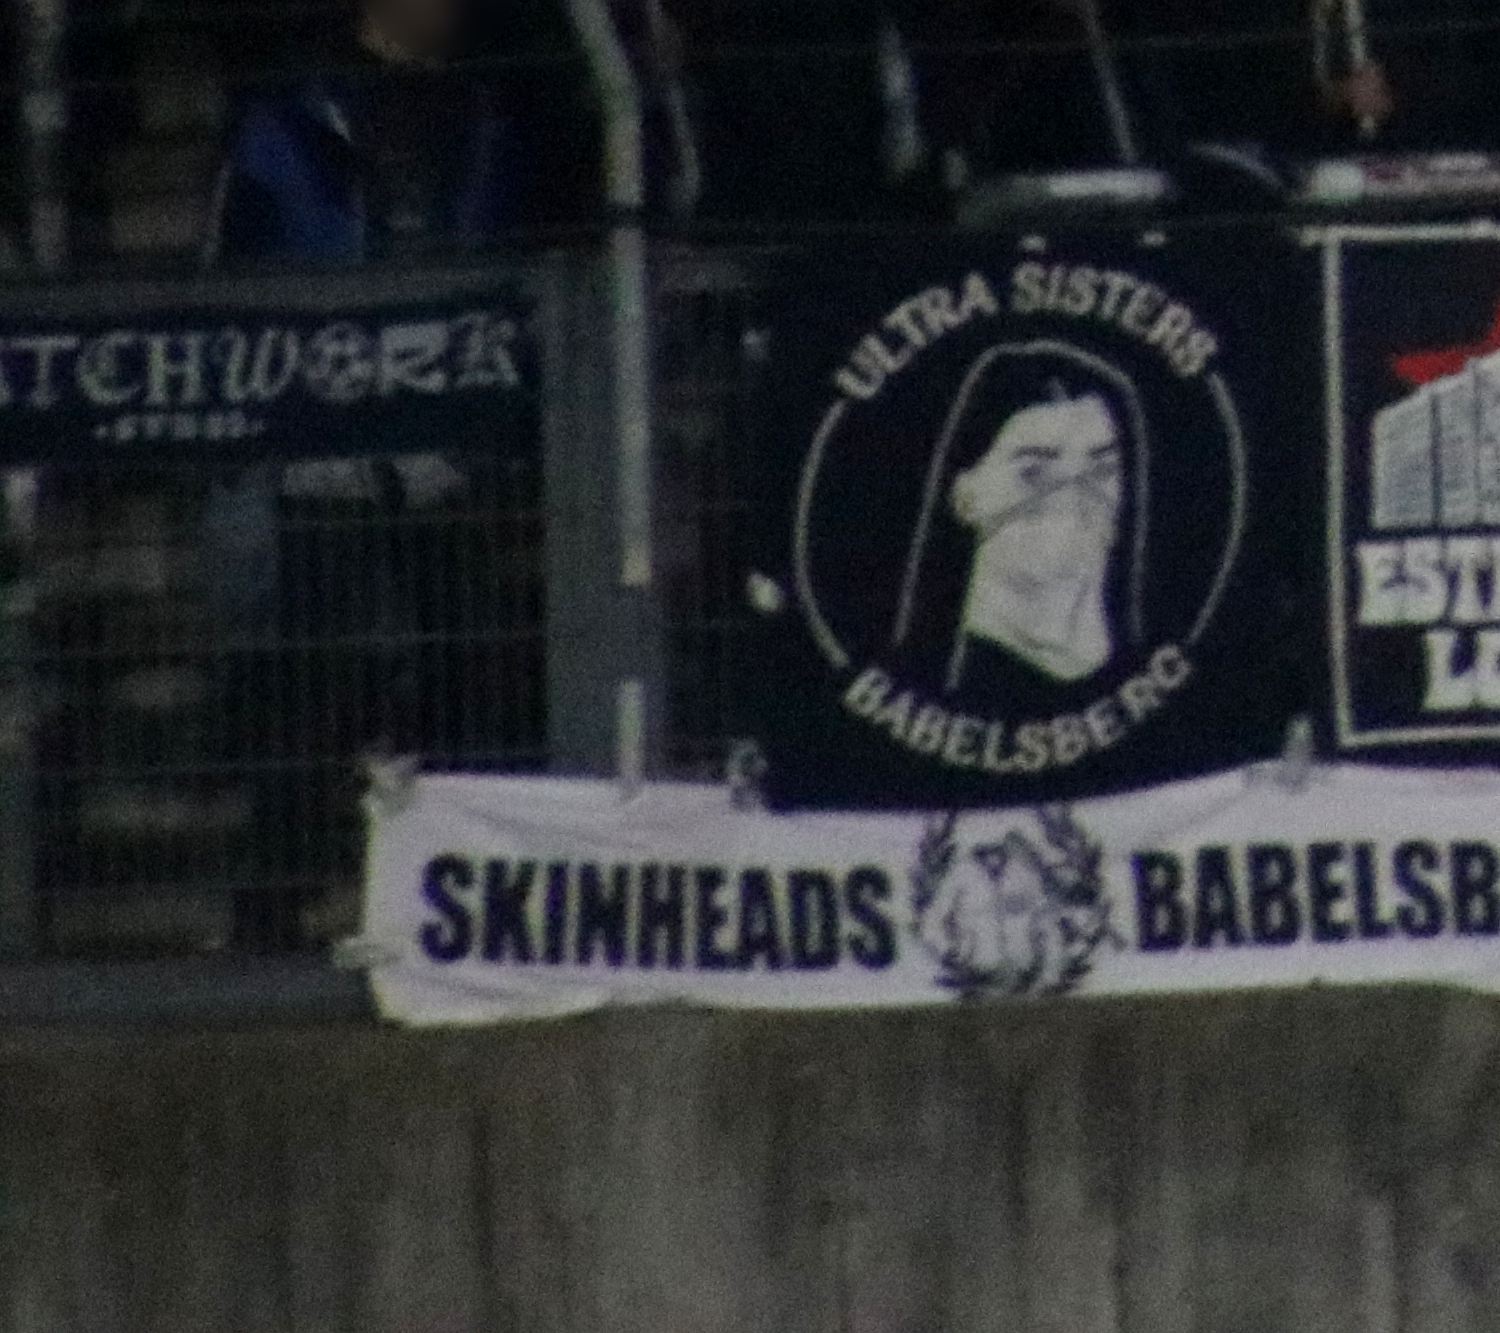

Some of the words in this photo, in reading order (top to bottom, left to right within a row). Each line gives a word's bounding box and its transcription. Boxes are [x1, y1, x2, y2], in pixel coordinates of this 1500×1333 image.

[0, 310, 521, 409] TCHWORK
[834, 270, 999, 401] ULTRA
[1011, 262, 1218, 378] SISTERS
[841, 643, 1194, 774] BABELSBERG
[418, 851, 896, 970] SKINHEADS
